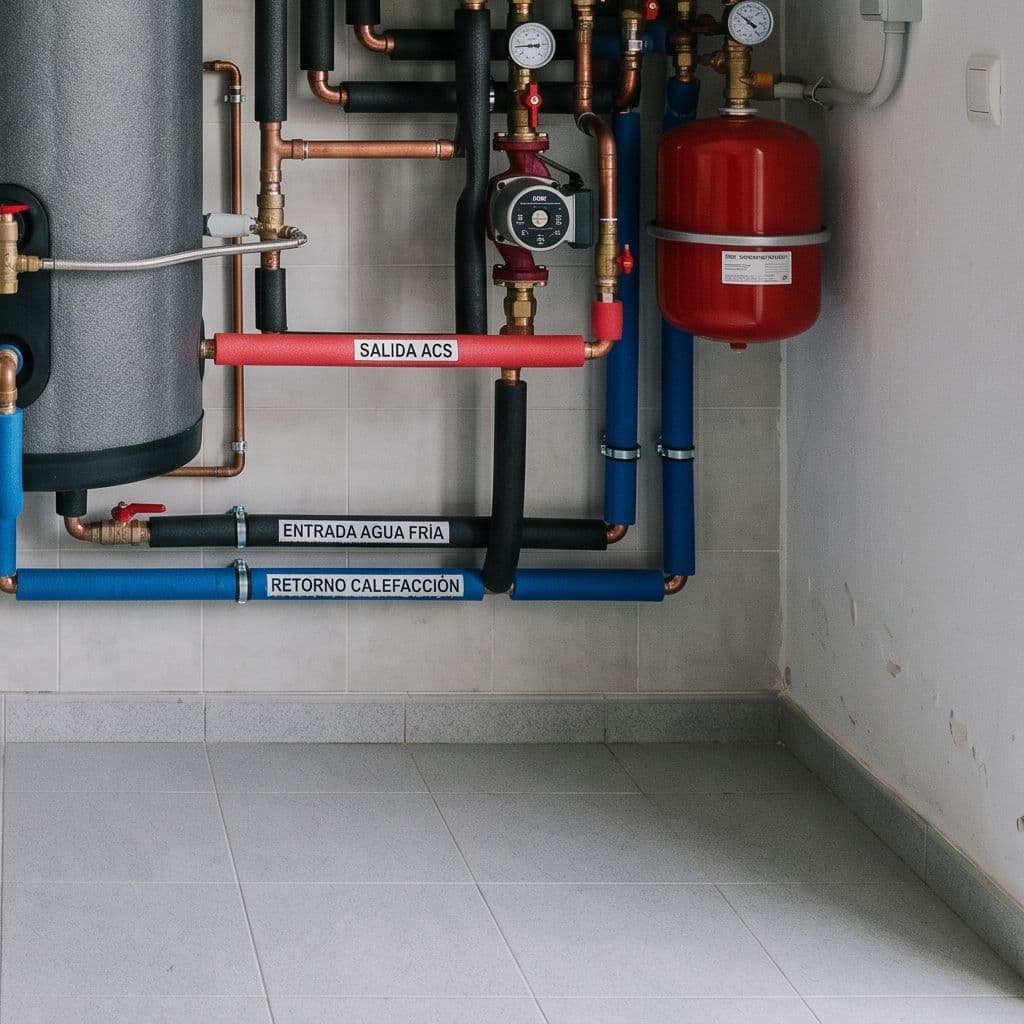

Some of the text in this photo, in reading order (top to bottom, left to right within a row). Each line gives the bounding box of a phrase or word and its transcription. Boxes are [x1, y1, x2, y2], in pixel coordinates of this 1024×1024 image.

[360, 343, 453, 358] SALIDA ACS
[283, 523, 357, 538] ENTRADA
[360, 524, 404, 539] AGUA
[271, 574, 460, 593] RETORNO CALEFACCIÓN
